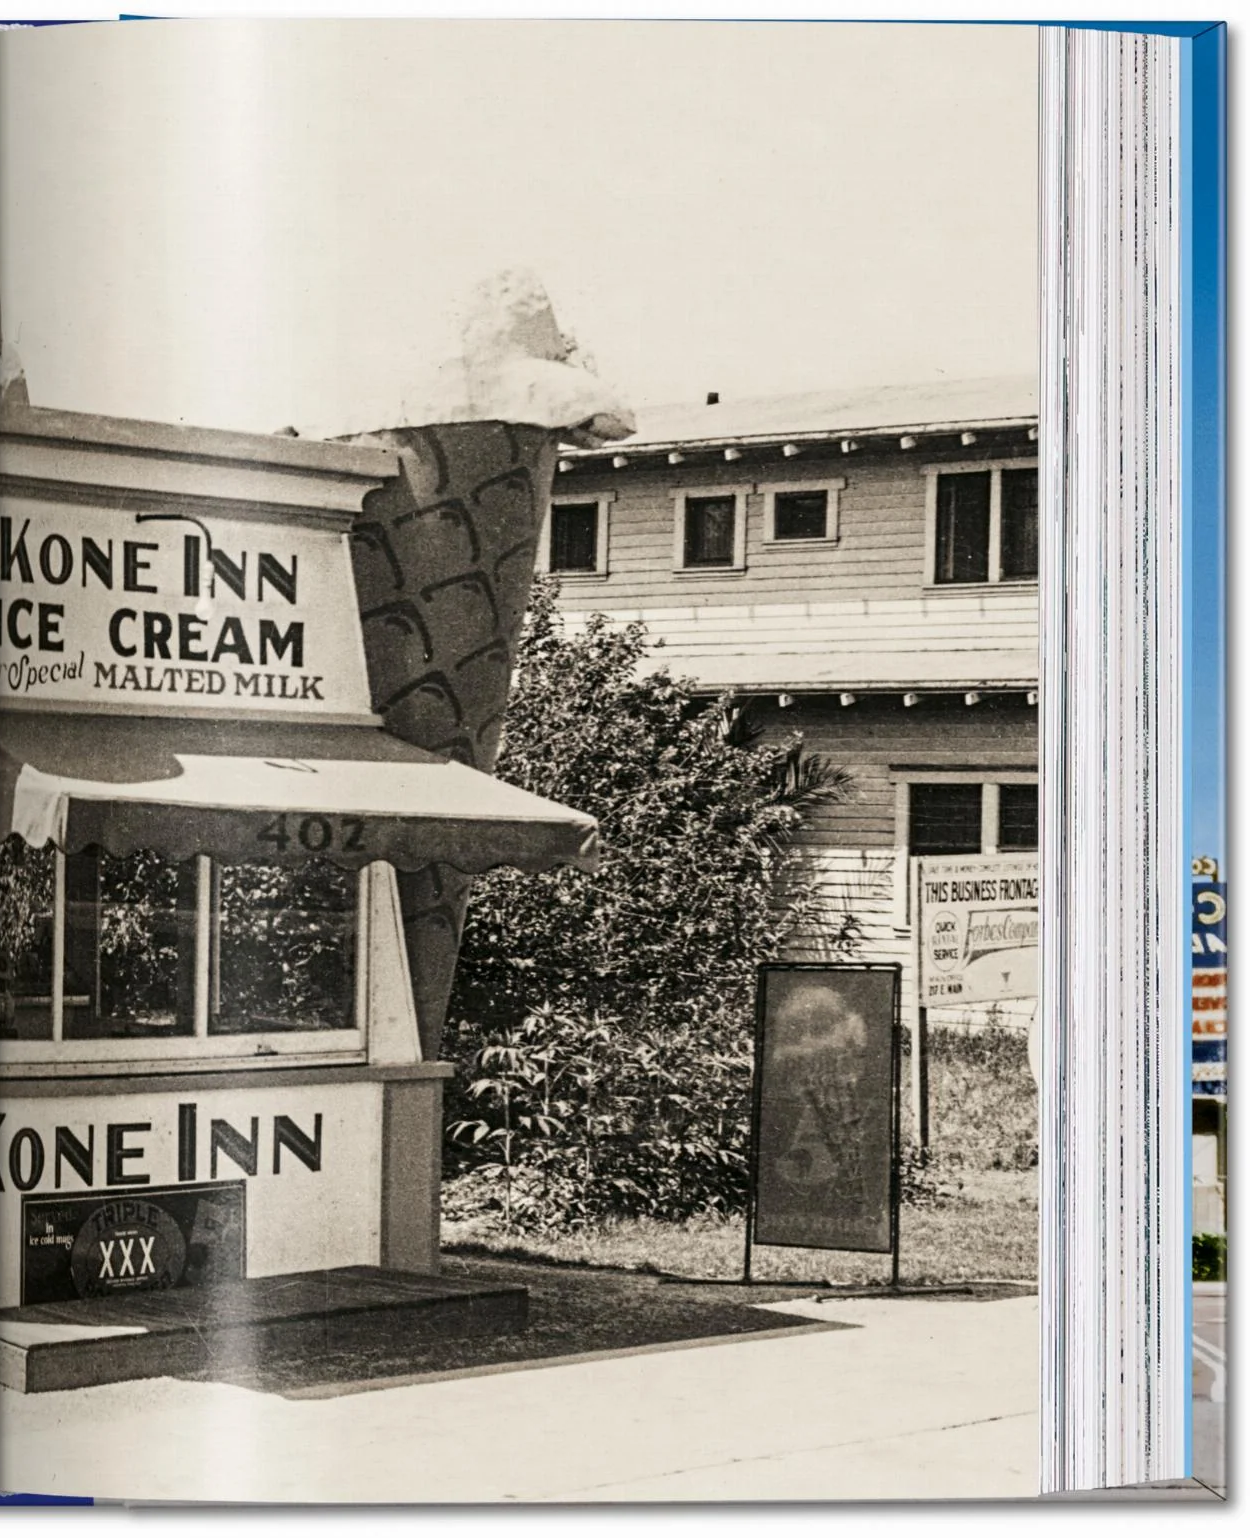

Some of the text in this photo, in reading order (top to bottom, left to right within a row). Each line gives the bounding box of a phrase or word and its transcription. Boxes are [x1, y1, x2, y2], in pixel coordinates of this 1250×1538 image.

[0, 516, 299, 605] KONE INN
[108, 607, 305, 668] CREAM
[8, 651, 86, 693] Special
[93, 661, 226, 695] MALTED
[233, 671, 325, 700] MILK
[256, 813, 366, 852] 402
[925, 881, 949, 904] THIS
[951, 879, 998, 903] BUSINESS
[935, 921, 956, 934] QUICK
[933, 948, 959, 961] SERVICE
[178, 1103, 323, 1182] INN
[94, 1200, 162, 1233] TRIPLE
